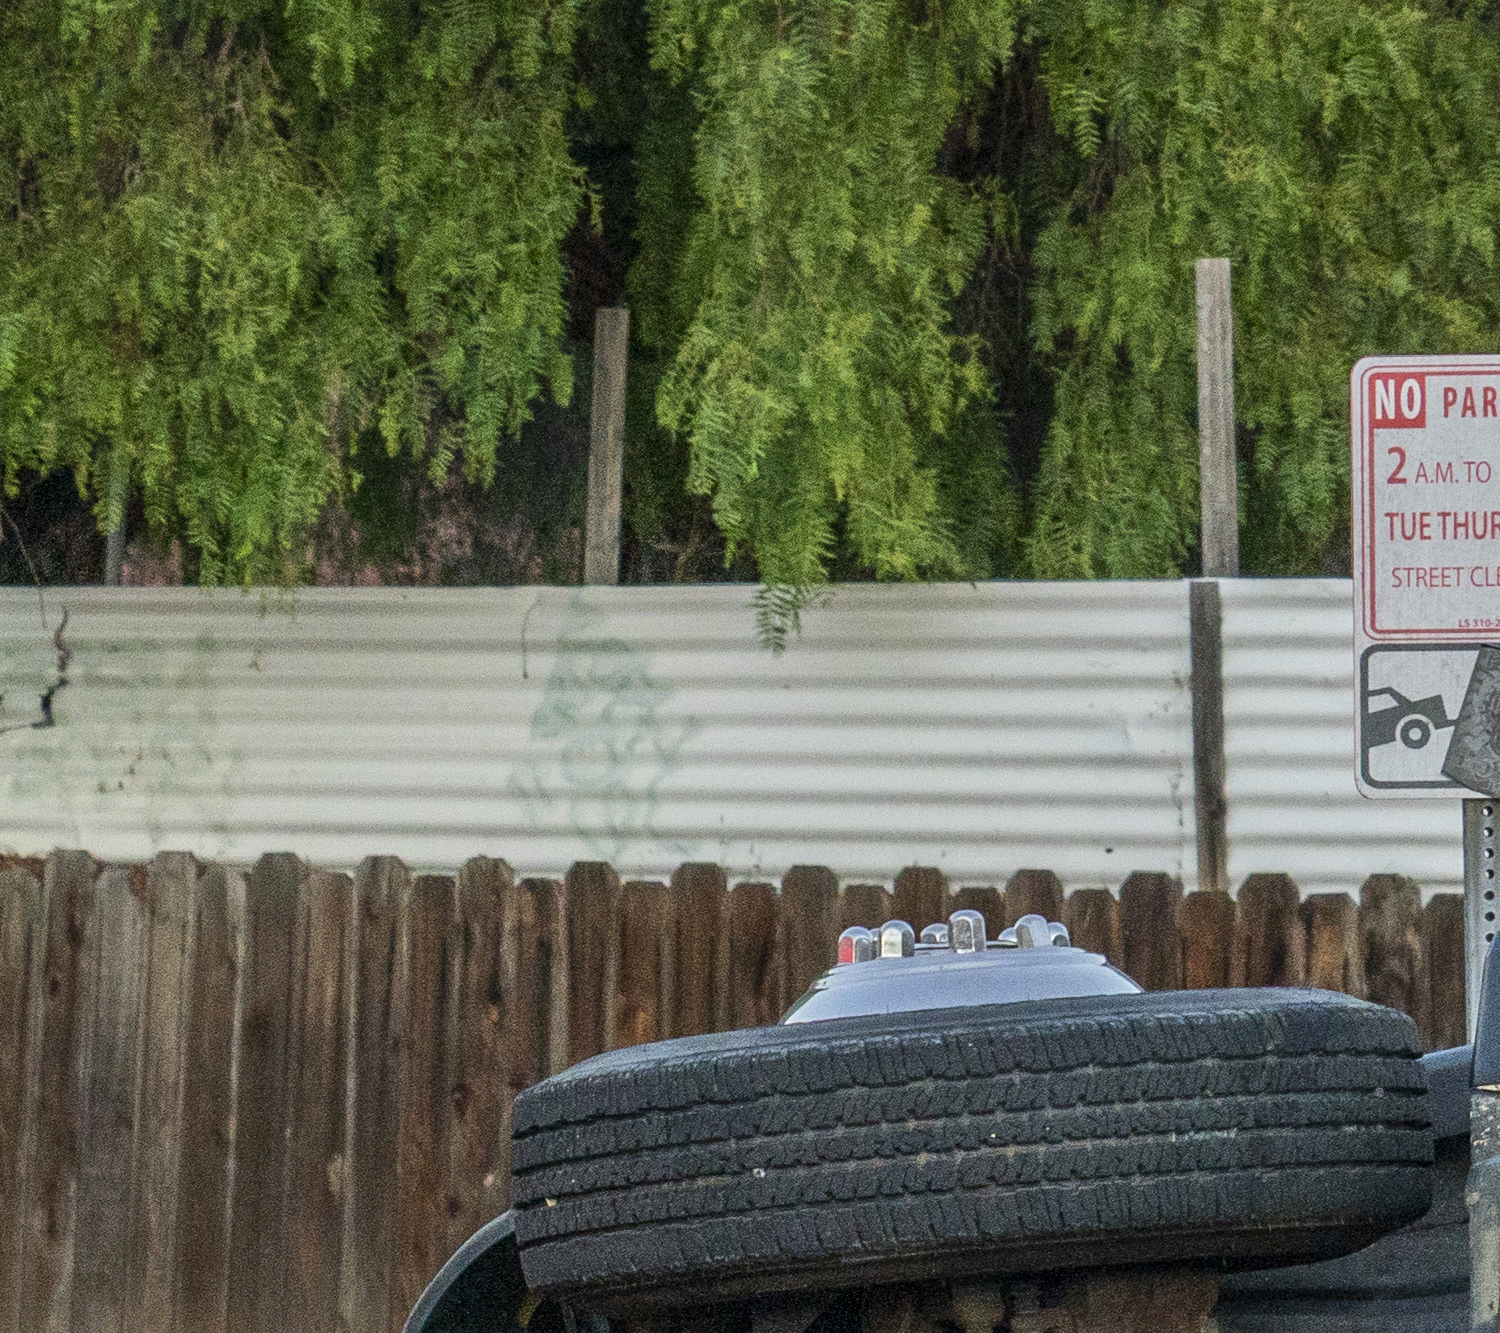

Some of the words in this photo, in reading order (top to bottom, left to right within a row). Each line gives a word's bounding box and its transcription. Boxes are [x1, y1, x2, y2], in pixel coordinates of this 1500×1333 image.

[1375, 378, 1422, 420] NO
[1443, 386, 1498, 418] PAR
[1386, 446, 1408, 485] 2
[1414, 461, 1460, 484] A.M.
[1463, 461, 1492, 484] TO
[1384, 512, 1433, 541] TUE
[1391, 567, 1465, 588] STREET
